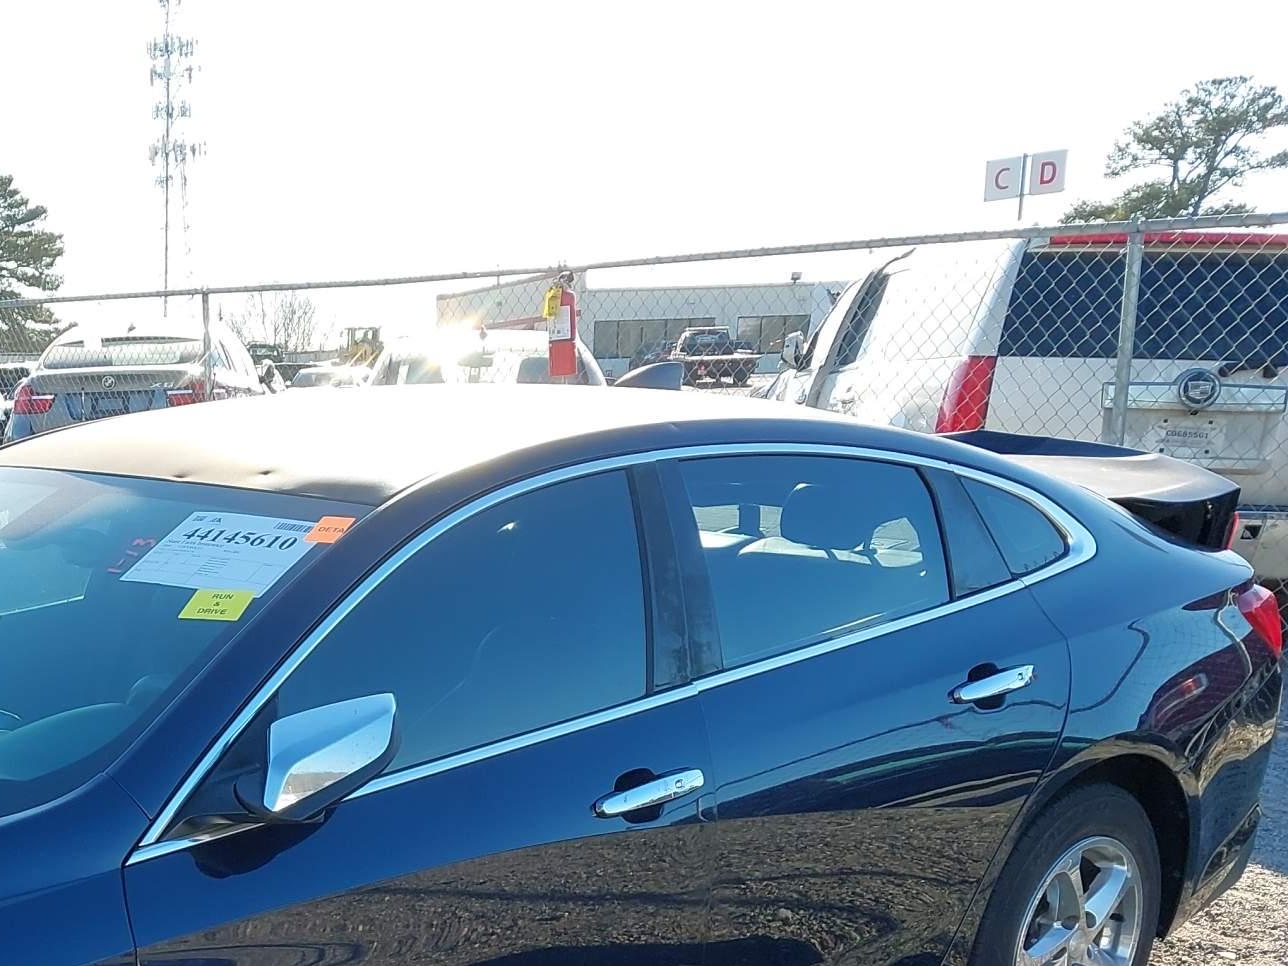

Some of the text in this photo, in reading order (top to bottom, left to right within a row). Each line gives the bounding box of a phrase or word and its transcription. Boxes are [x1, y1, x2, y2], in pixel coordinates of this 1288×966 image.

[994, 167, 1011, 190] C
[1039, 160, 1057, 185] D
[182, 527, 298, 551] 44145610
